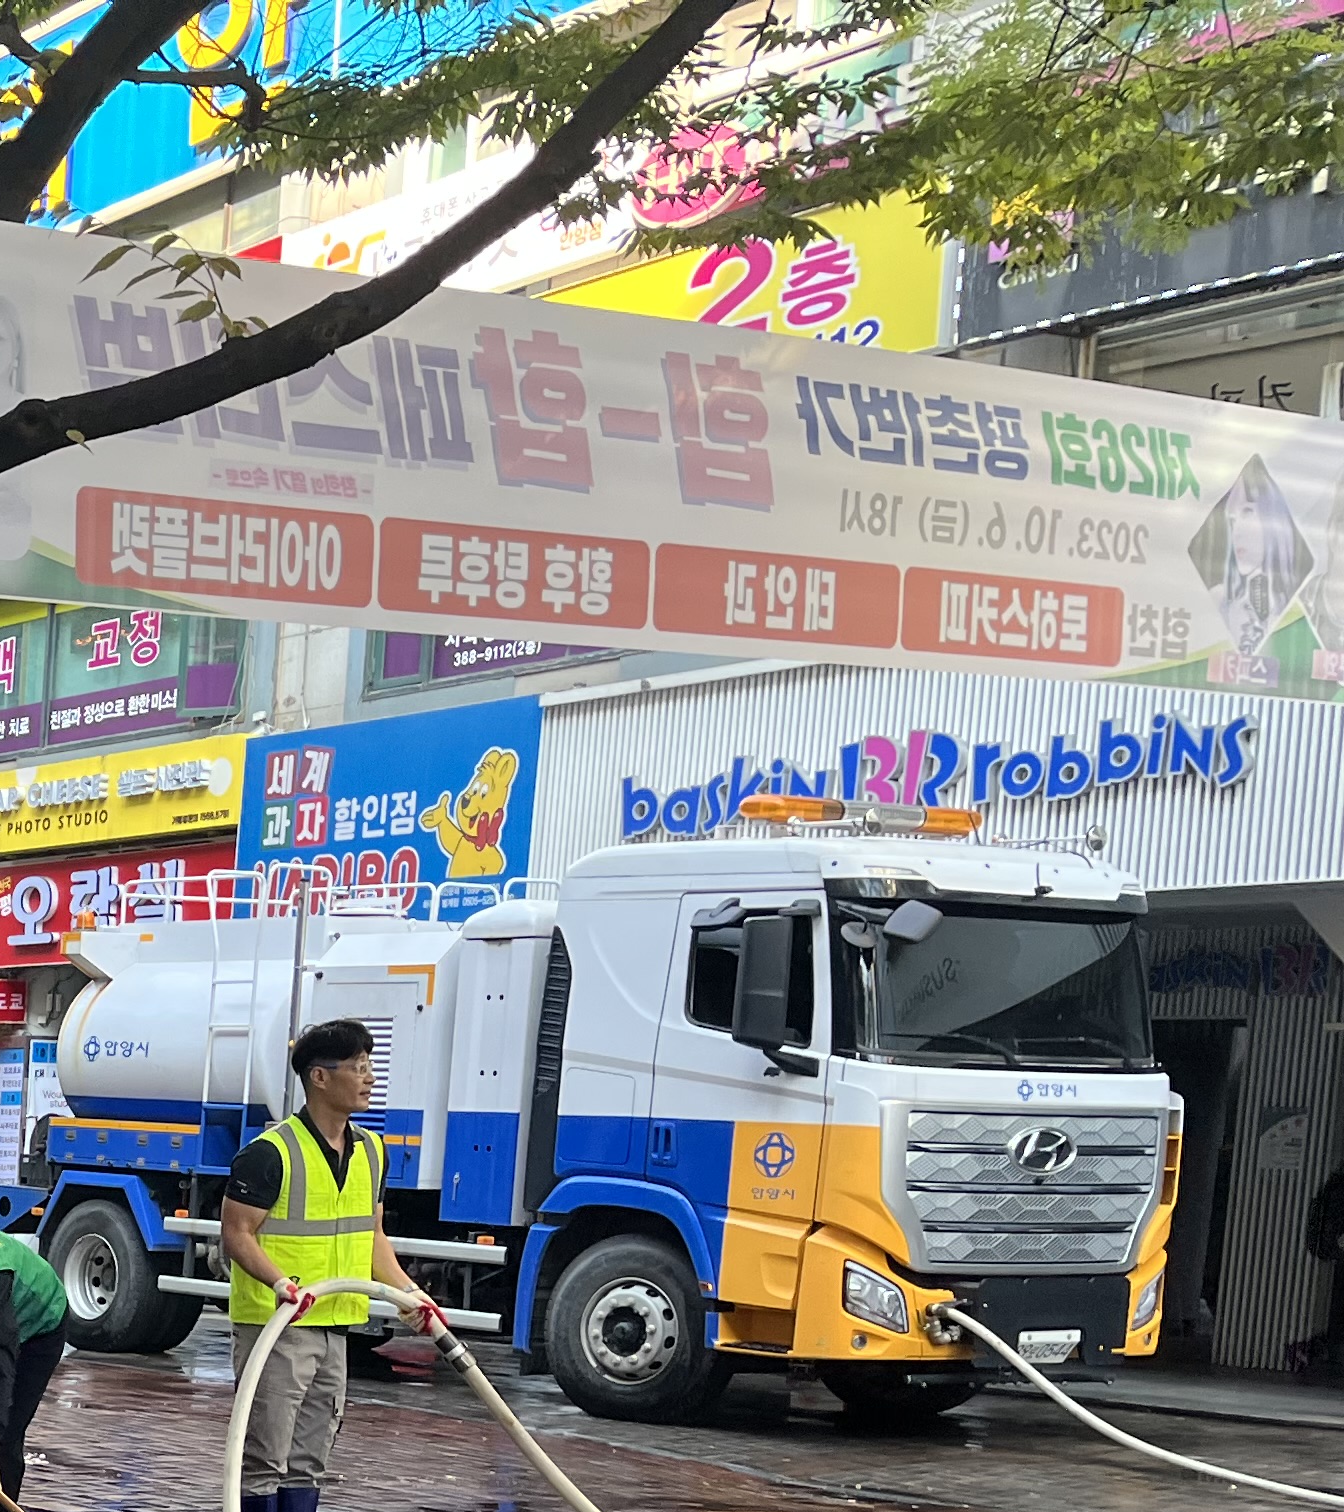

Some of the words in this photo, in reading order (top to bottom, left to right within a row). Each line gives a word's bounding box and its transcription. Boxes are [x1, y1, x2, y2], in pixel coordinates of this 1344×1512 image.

[86, 609, 163, 671] 교정
[8, 717, 31, 737] 치료
[49, 707, 82, 731] 친절과
[83, 700, 125, 726] 정성으로
[266, 749, 330, 797] 세계
[27, 772, 109, 809] CHEESE
[7, 814, 51, 836] PHOTO
[57, 808, 109, 830] STUDIO
[262, 799, 325, 847] 과자
[334, 790, 417, 842] 할인점
[104, 1040, 150, 1058] 안양시
[1036, 1082, 1078, 1098] 안양시
[750, 1185, 796, 1201] 안양시
